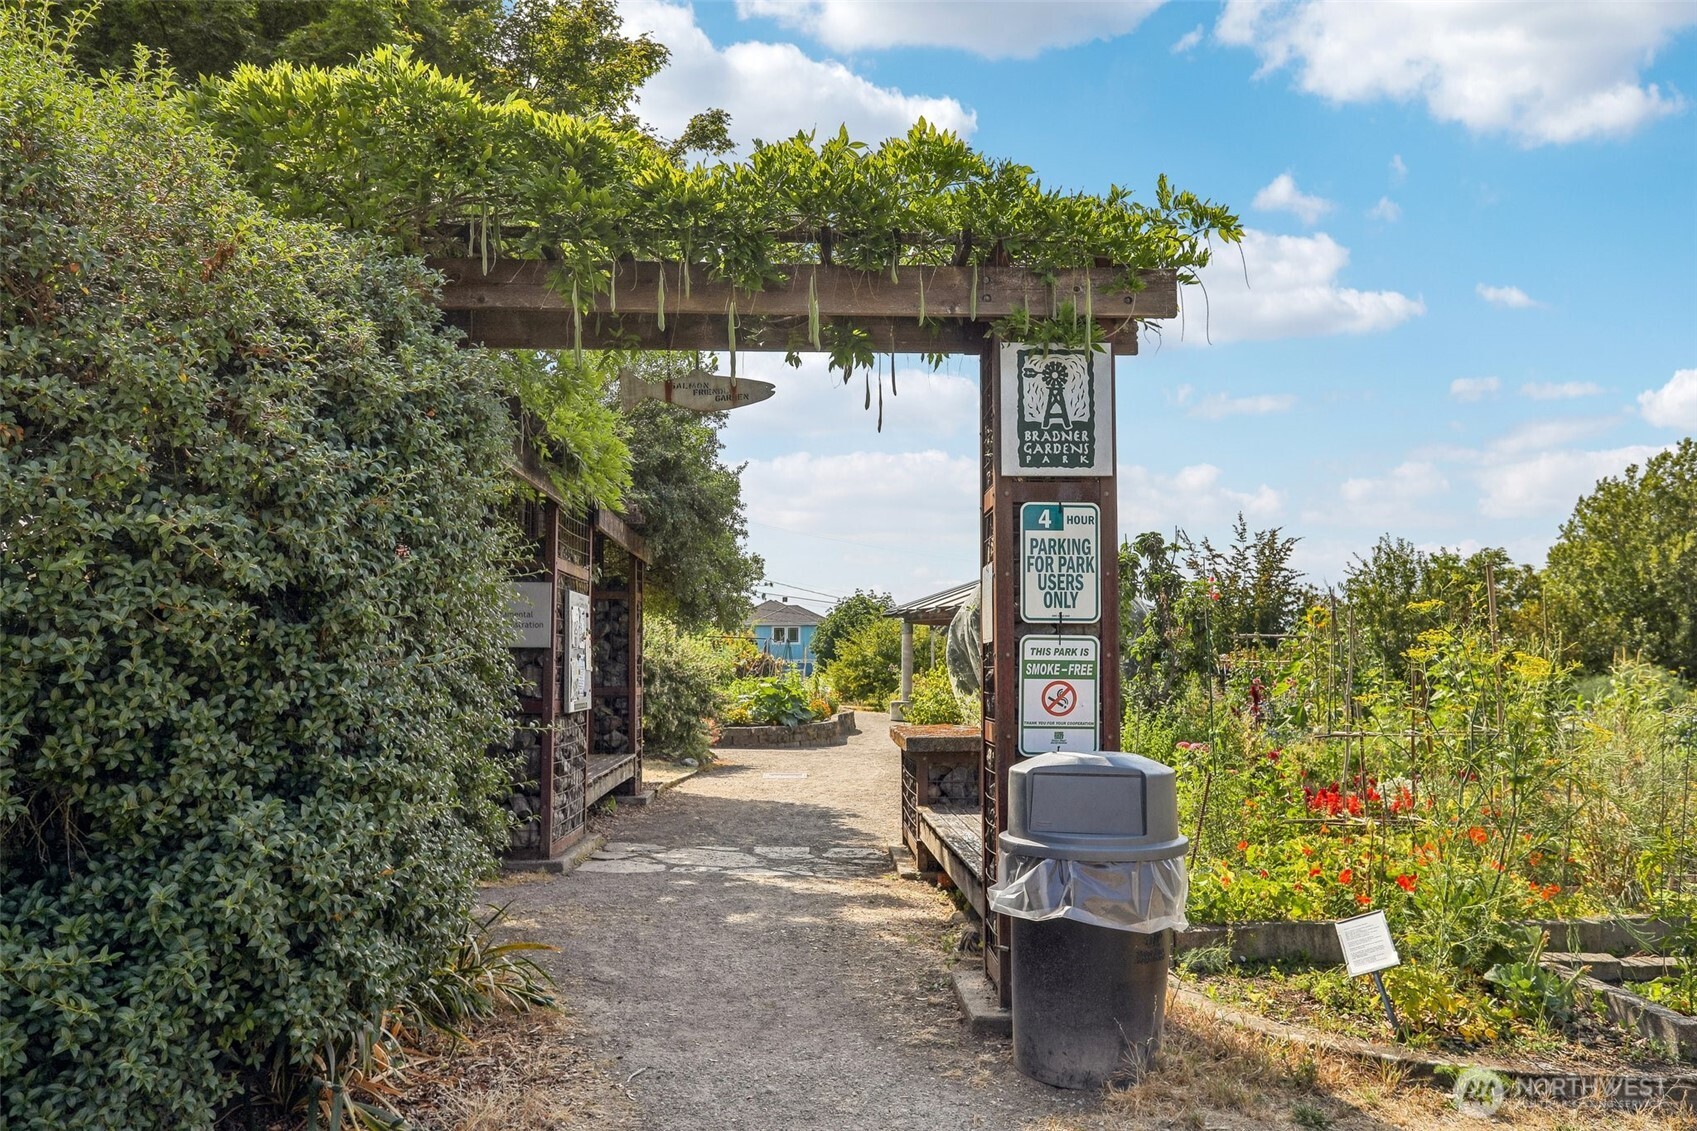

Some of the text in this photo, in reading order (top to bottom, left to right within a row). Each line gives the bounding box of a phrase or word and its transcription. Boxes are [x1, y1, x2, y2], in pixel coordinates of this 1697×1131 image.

[671, 382, 709, 390] SALMON
[715, 393, 750, 402] GAREN
[1024, 430, 1089, 441] BRADNER
[1023, 442, 1089, 454] GARDENS
[1026, 455, 1090, 464] PARK
[1038, 509, 1095, 529] 4 HOUR
[1030, 538, 1091, 555] PARKING
[1027, 556, 1095, 573] FOR PARK
[1037, 573, 1084, 591] USERS
[1043, 591, 1079, 609] ONLY
[1030, 647, 1090, 656] THIS PARK IS
